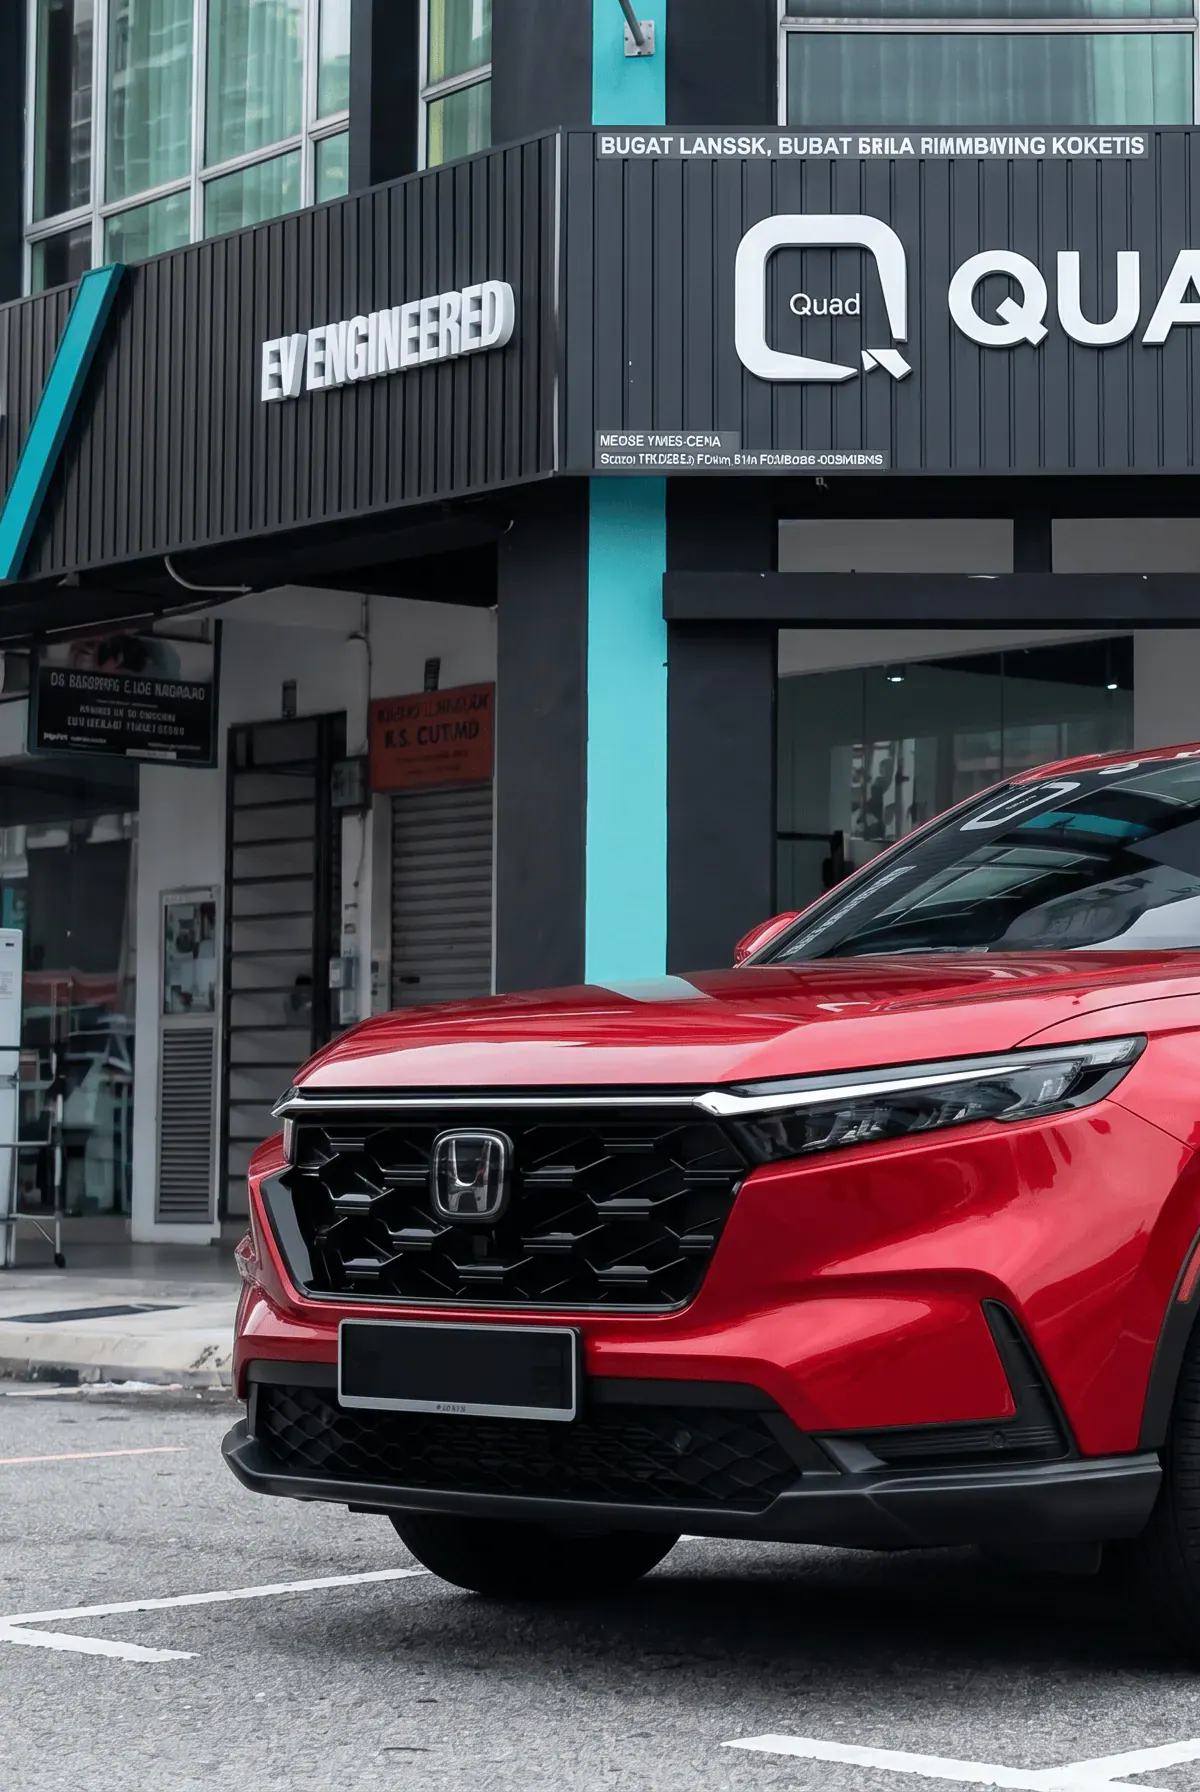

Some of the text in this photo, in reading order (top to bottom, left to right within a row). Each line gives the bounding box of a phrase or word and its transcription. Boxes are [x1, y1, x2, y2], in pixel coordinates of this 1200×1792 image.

[601, 136, 673, 155] BUGAT
[680, 136, 772, 157] LANSSK,
[778, 137, 852, 155] BUBAT
[1052, 136, 1145, 155] KOKETIS
[789, 292, 861, 316] Quad
[261, 279, 516, 402] EV ENGINEERED
